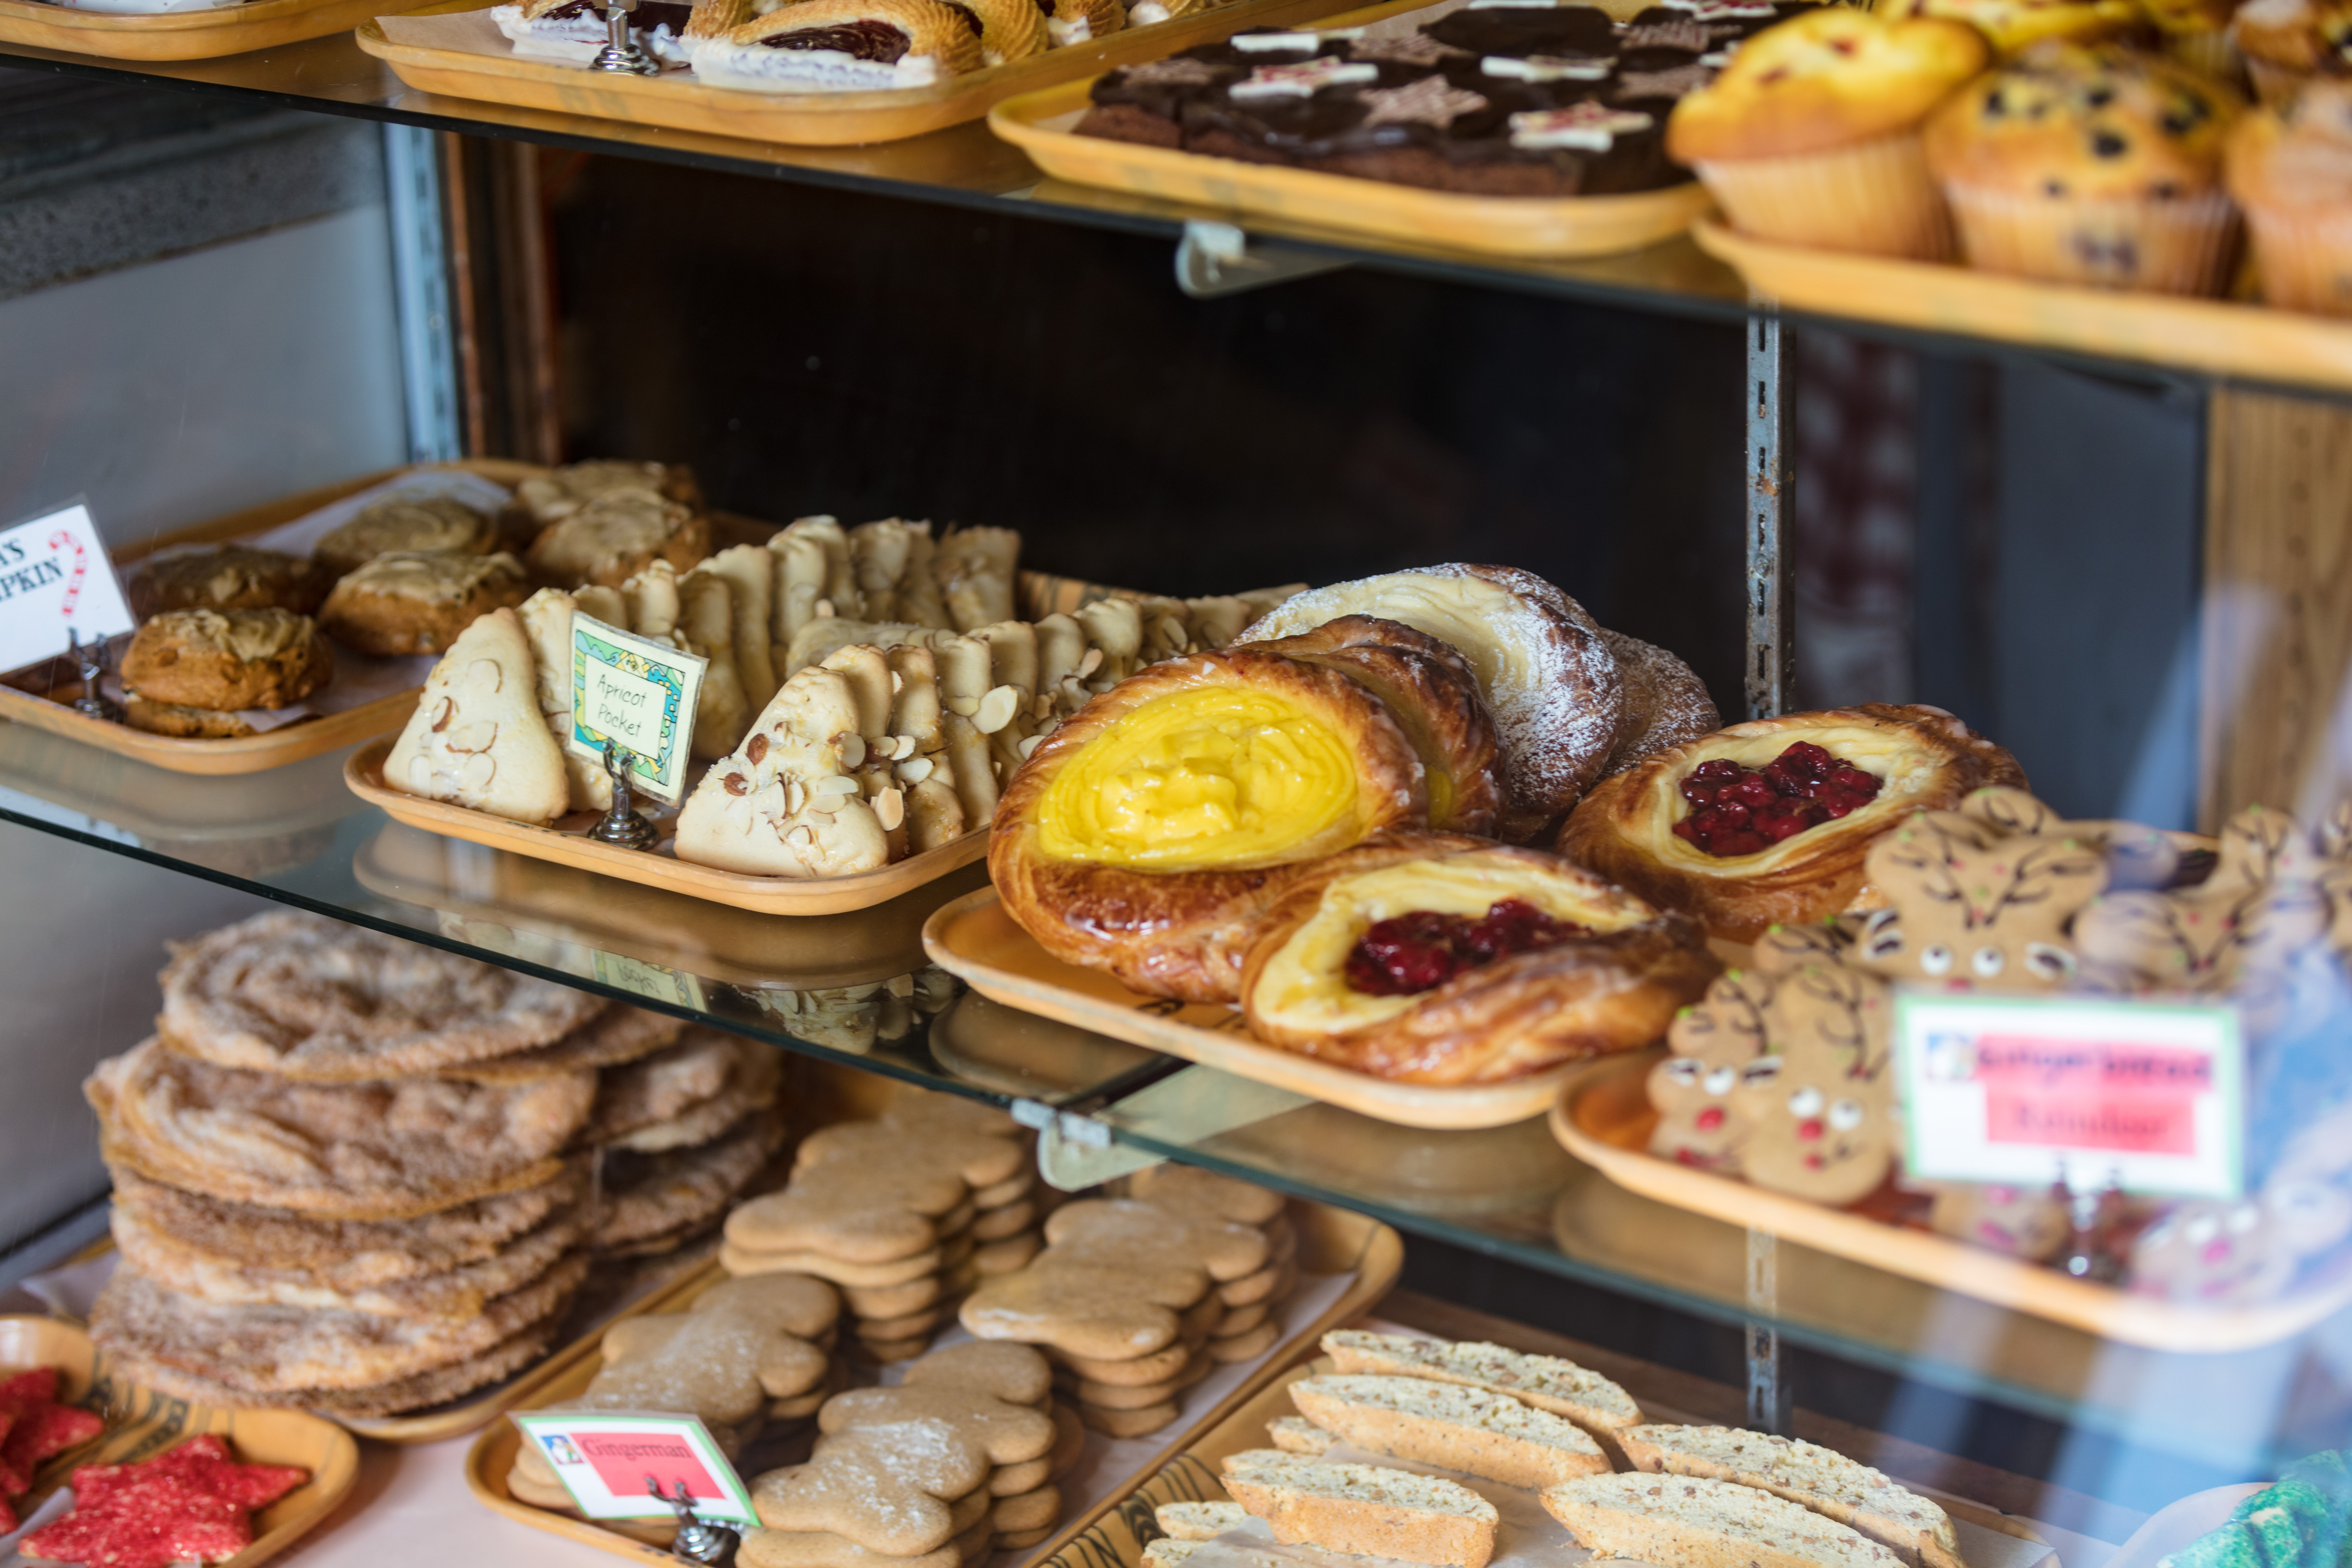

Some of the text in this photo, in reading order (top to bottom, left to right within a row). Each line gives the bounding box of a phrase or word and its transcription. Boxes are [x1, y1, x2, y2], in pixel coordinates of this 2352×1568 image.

[0, 556, 62, 601] PKIN
[597, 674, 647, 708] Apricot
[598, 703, 642, 737] Pocket
[582, 1439, 692, 1461] Gingerman
